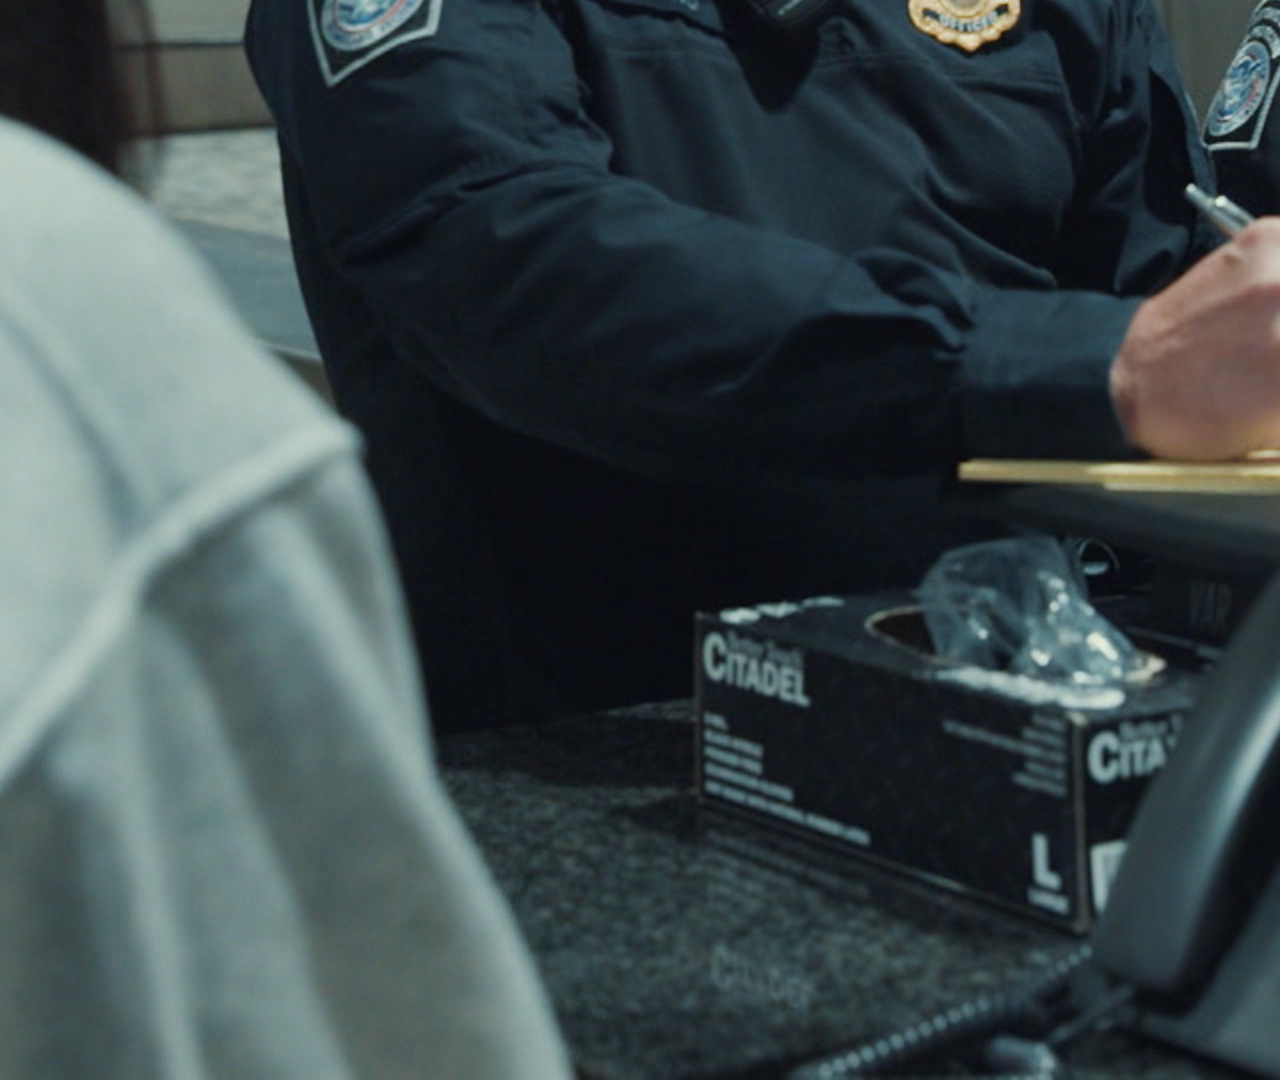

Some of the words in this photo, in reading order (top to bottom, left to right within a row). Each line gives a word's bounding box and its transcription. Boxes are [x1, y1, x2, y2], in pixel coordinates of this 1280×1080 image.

[703, 631, 812, 709] CITADEL
[1087, 731, 1179, 785] CITA
[1031, 832, 1063, 892] L
